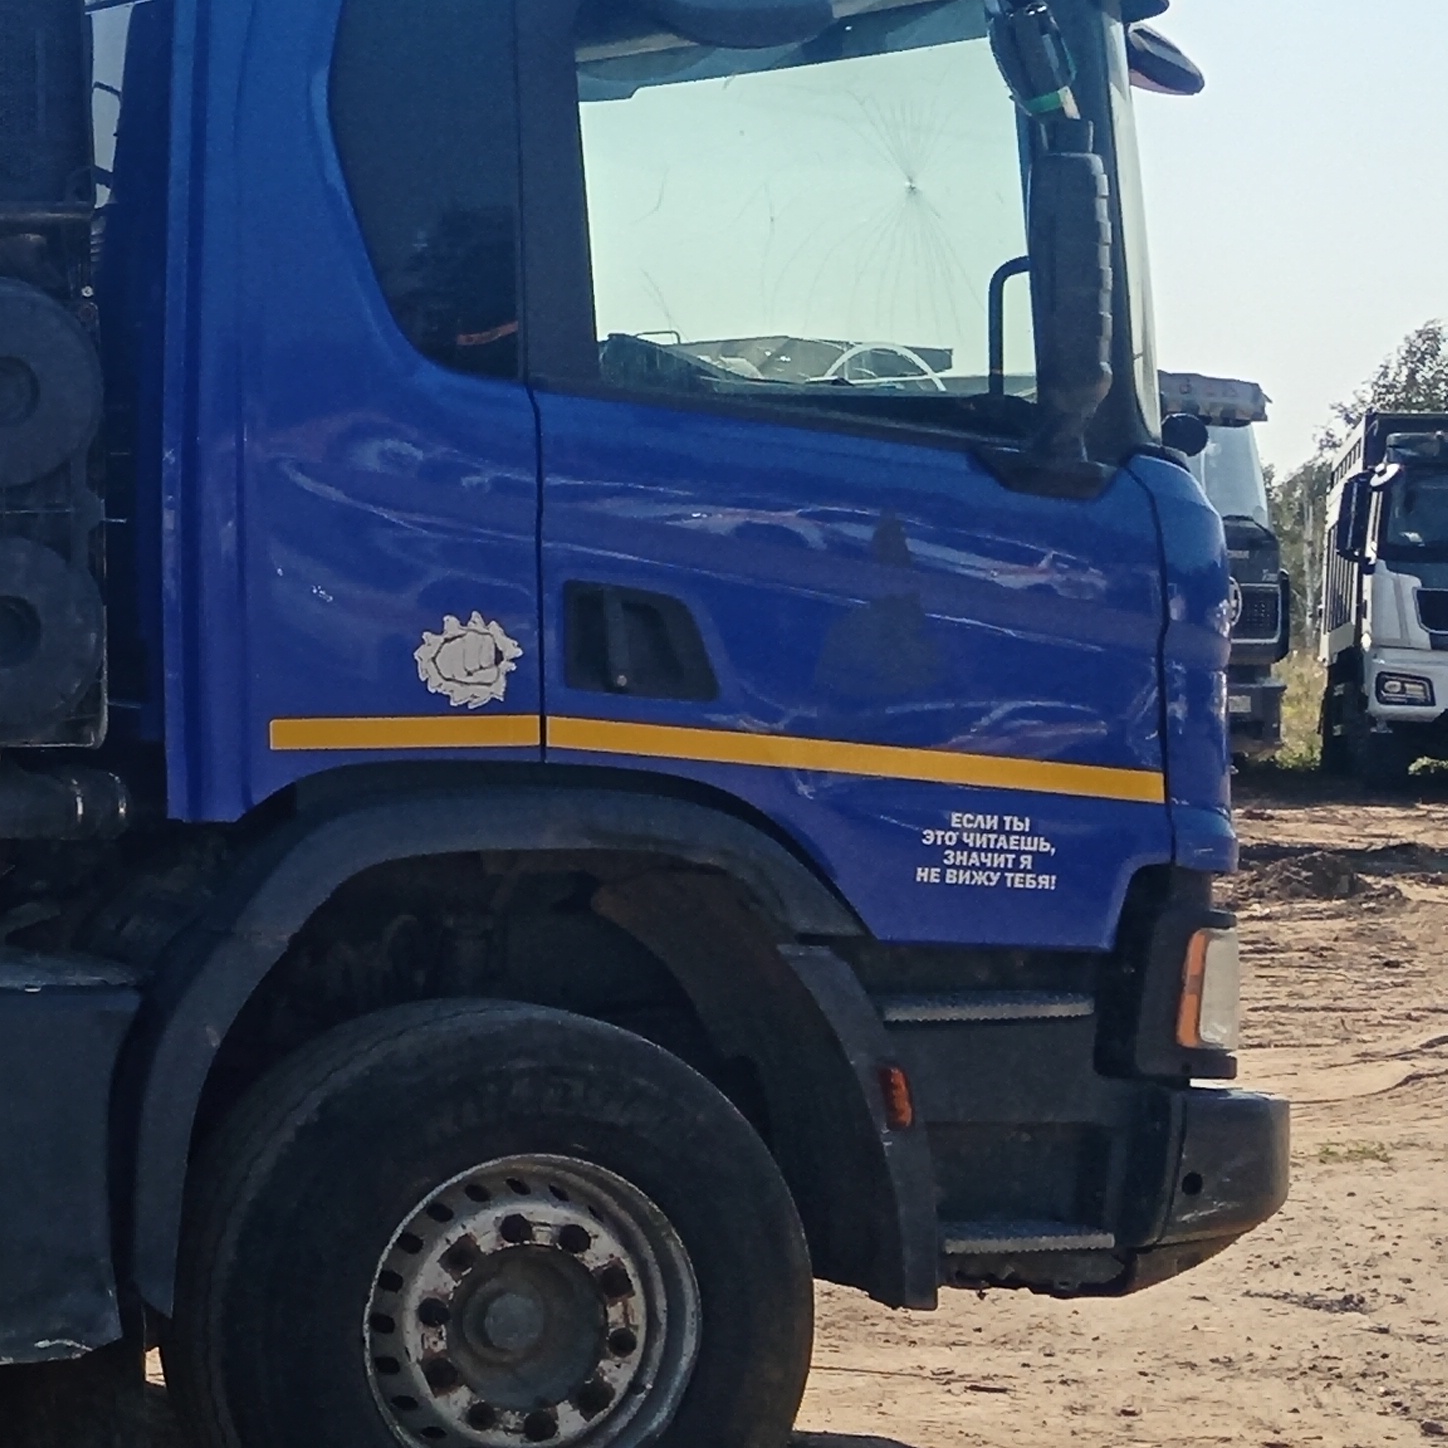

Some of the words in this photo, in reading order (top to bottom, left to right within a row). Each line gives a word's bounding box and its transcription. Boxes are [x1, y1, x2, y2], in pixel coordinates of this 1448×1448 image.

[951, 813, 998, 830] ЕСЛИ
[1003, 815, 1031, 831] ТЫ
[922, 830, 957, 846] ЭТО
[962, 831, 1057, 856] ЧИТАЕШЬ,
[943, 851, 1015, 868] ЗНАЧИТ
[1019, 854, 1032, 869] Я
[916, 868, 941, 883] НЕ
[945, 870, 1001, 886] ВИЖУ
[1005, 873, 1057, 890] ТЕБЯ!
